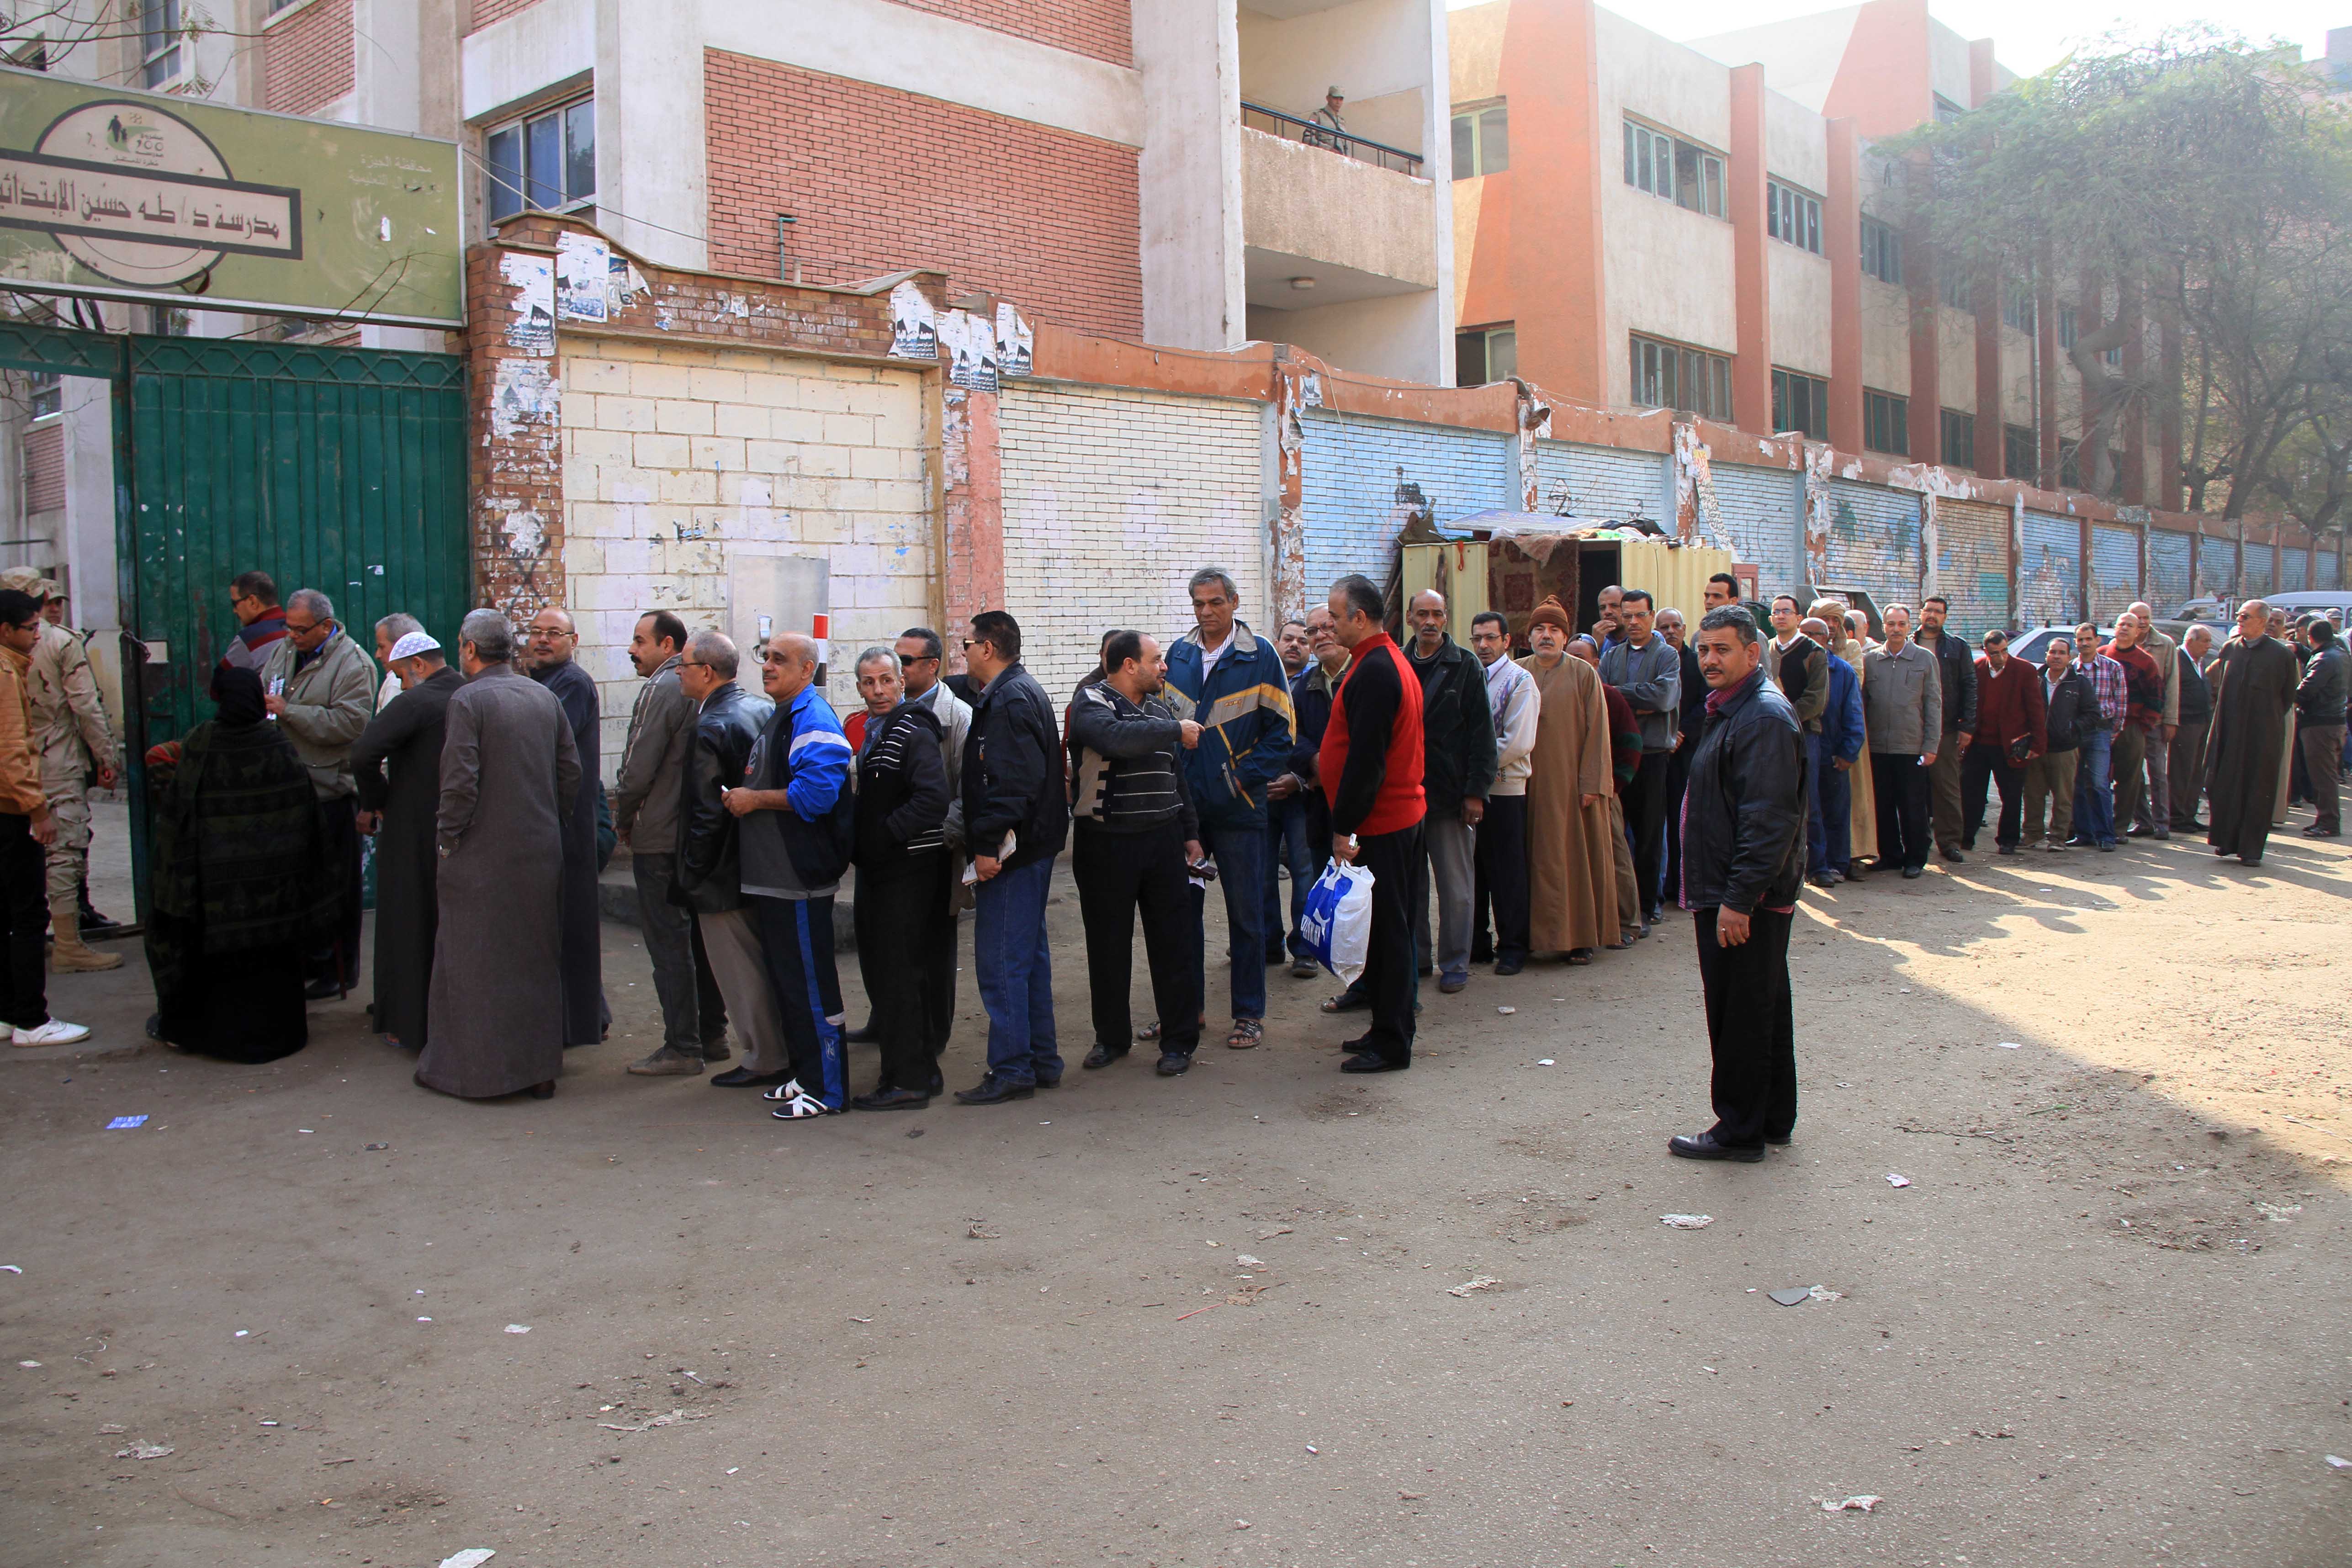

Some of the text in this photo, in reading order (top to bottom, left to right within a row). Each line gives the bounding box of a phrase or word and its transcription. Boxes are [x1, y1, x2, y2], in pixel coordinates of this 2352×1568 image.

[0, 171, 76, 217] الإبتدائي
[81, 192, 132, 222] حسين
[215, 204, 280, 239] مدرسة
